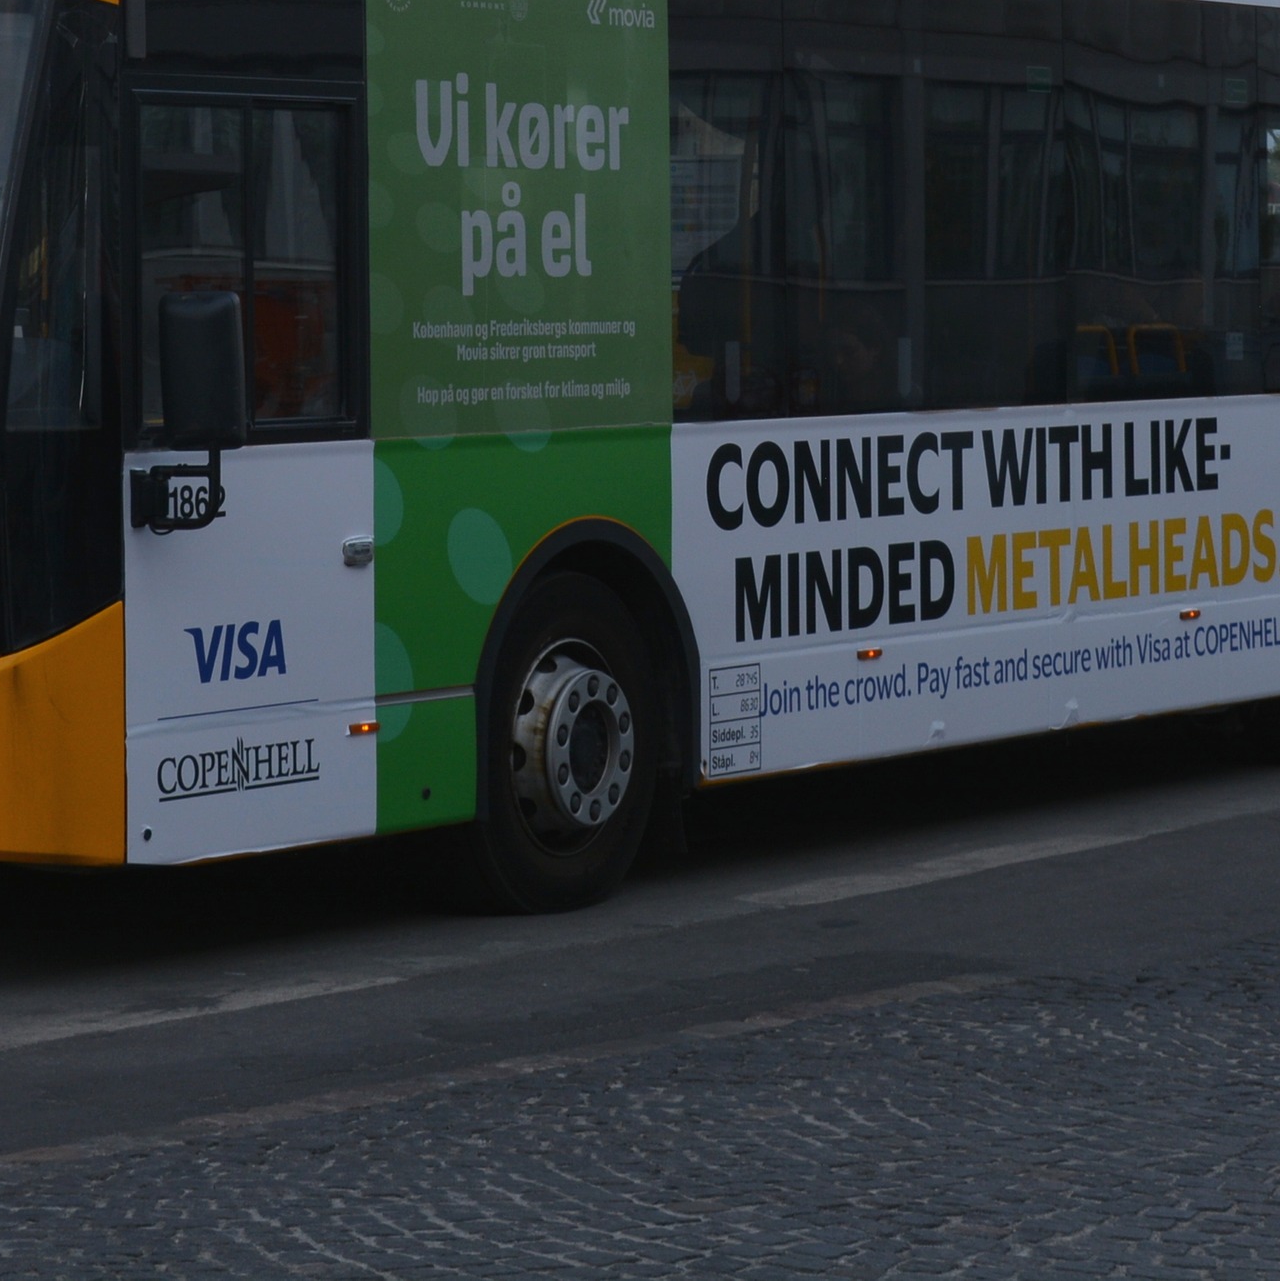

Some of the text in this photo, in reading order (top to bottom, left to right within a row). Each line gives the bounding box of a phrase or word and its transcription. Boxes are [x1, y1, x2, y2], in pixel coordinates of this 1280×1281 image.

[608, 3, 656, 29] movia
[415, 72, 629, 171] Vi kører
[461, 181, 592, 296] på el
[412, 318, 635, 340] København og Frederiksbergs kommuner og
[457, 342, 596, 363] Movia sikrer grøn transport
[417, 377, 631, 406] Hop på og gør en forskel for klima og miljø
[706, 417, 1231, 531] CONNECT WITH LIKE-
[735, 539, 955, 642] MINDED
[183, 619, 287, 684] VISA
[759, 679, 801, 717] Join
[806, 675, 840, 711] the
[844, 663, 912, 705] crowd.
[917, 662, 948, 699] Pay
[955, 655, 991, 689] fast
[993, 648, 1028, 684] and
[1032, 650, 1091, 680] secure
[1096, 636, 1133, 670] with
[1136, 633, 1171, 664] Visa
[1174, 631, 1191, 660] at
[712, 725, 746, 744] Siddepl.
[712, 753, 736, 770] Ståpl.
[157, 737, 320, 796] COPENHELL
